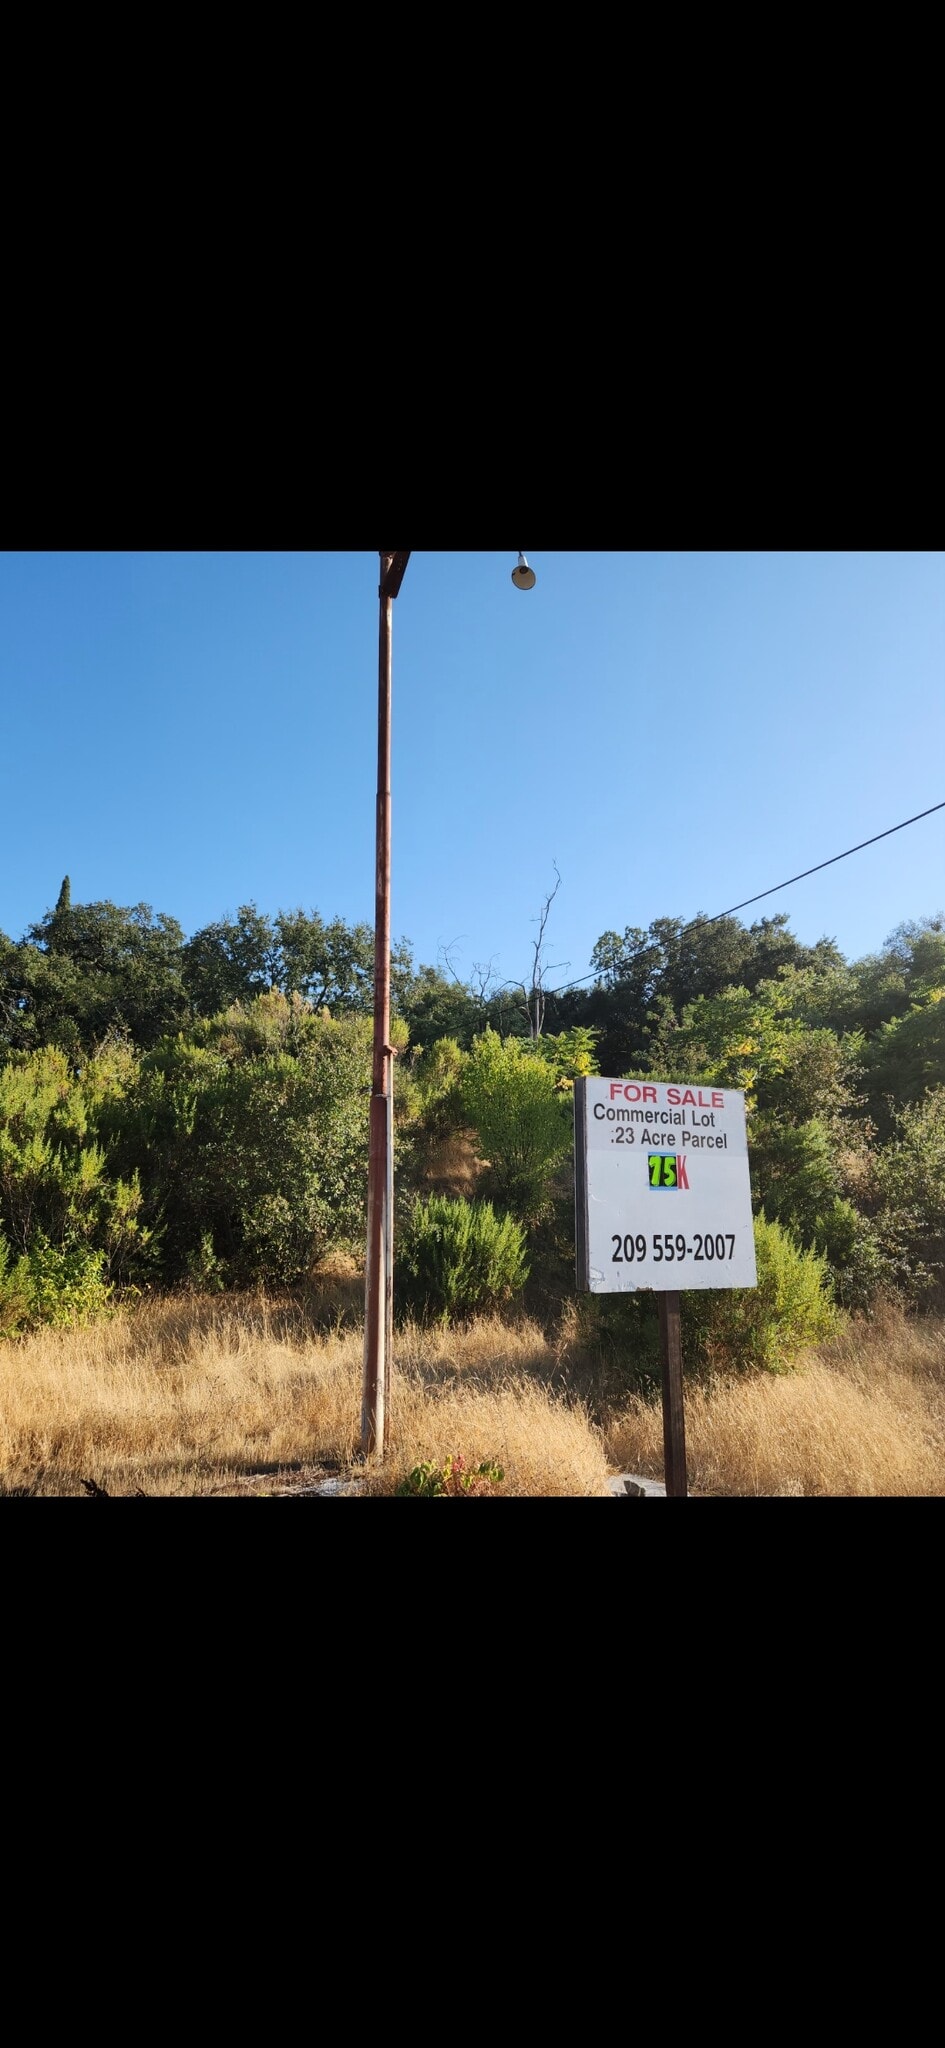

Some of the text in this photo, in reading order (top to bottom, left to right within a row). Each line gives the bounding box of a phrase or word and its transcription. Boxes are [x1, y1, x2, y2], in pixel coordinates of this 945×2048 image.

[610, 1083, 724, 1109] FOR SALE
[593, 1103, 715, 1127] Commercial Lot
[640, 1128, 676, 1147] Acre
[682, 1131, 728, 1149] Parcel
[611, 1234, 736, 1262] 209 559-2007
